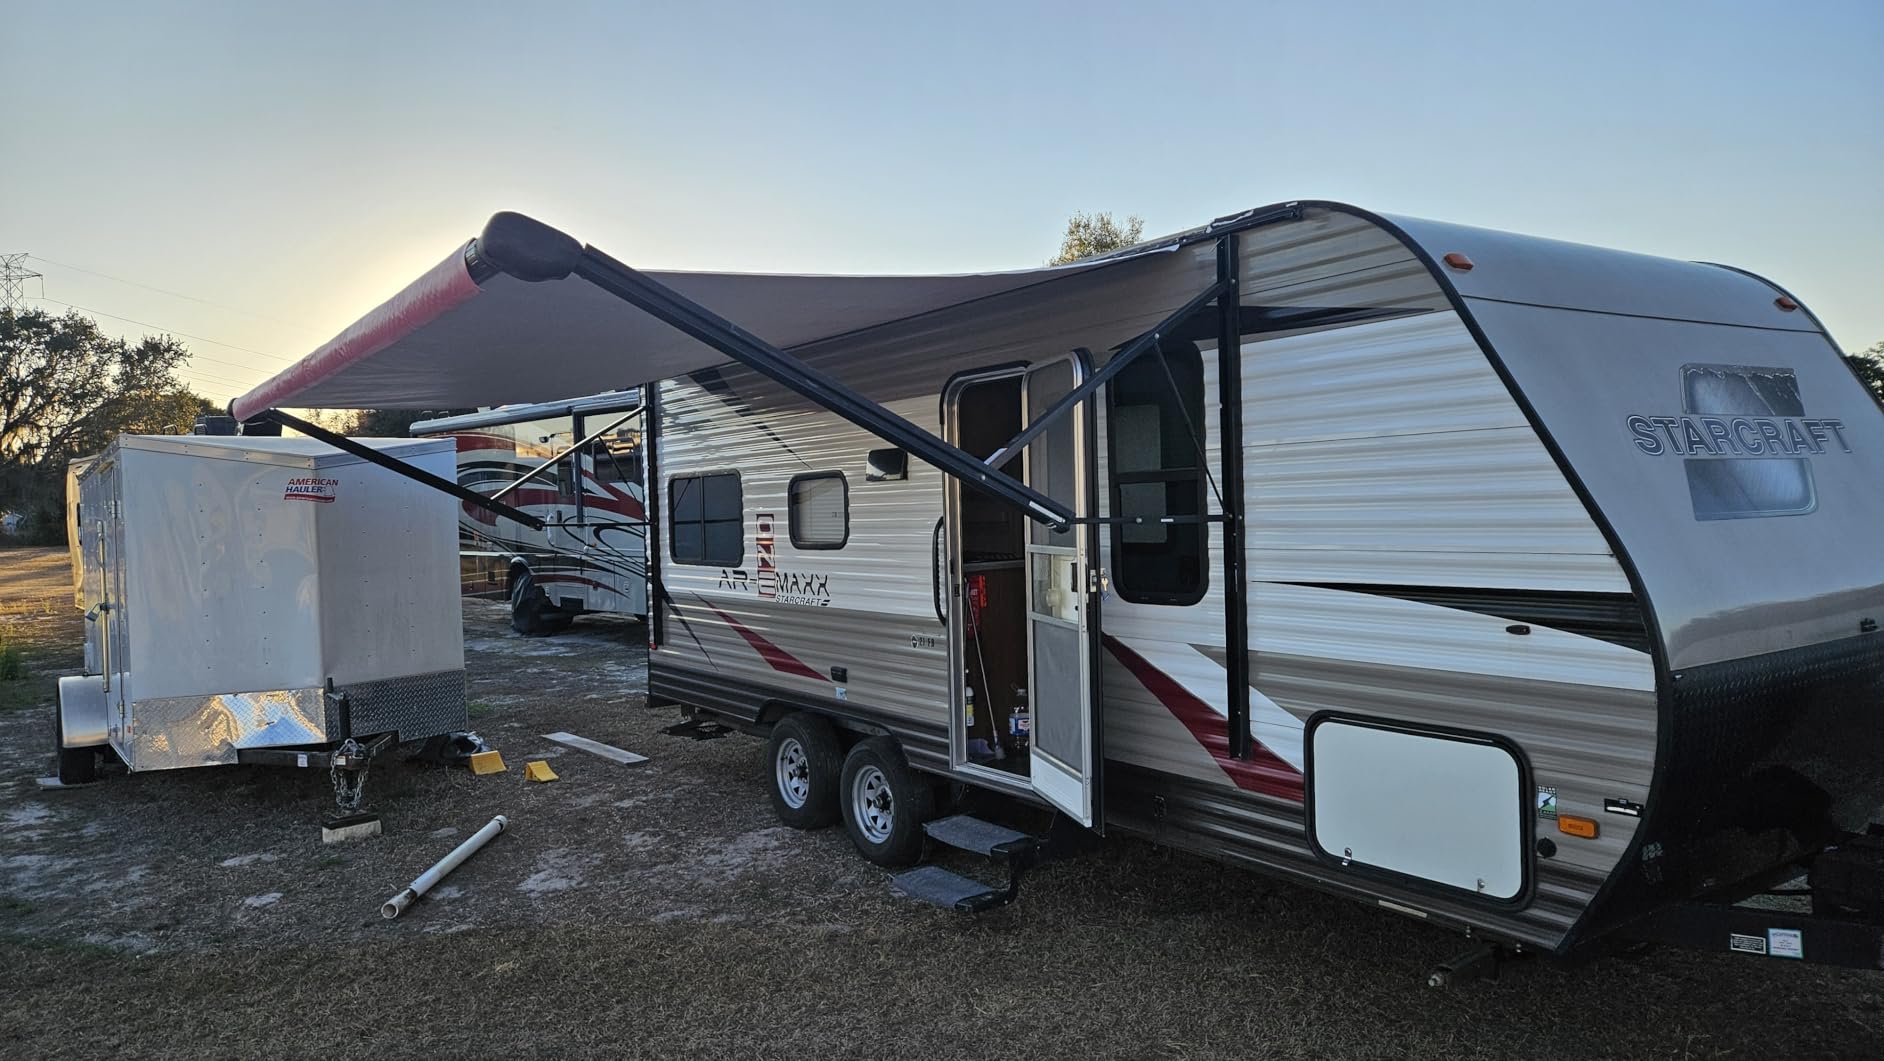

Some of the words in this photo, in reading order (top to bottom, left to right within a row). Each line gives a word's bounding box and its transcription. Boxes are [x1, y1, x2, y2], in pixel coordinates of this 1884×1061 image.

[1626, 415, 1852, 456] STARCRAFT
[287, 478, 339, 486] AMERICAN
[775, 572, 831, 597] MAXX
[775, 595, 822, 607] STARCRAFT
